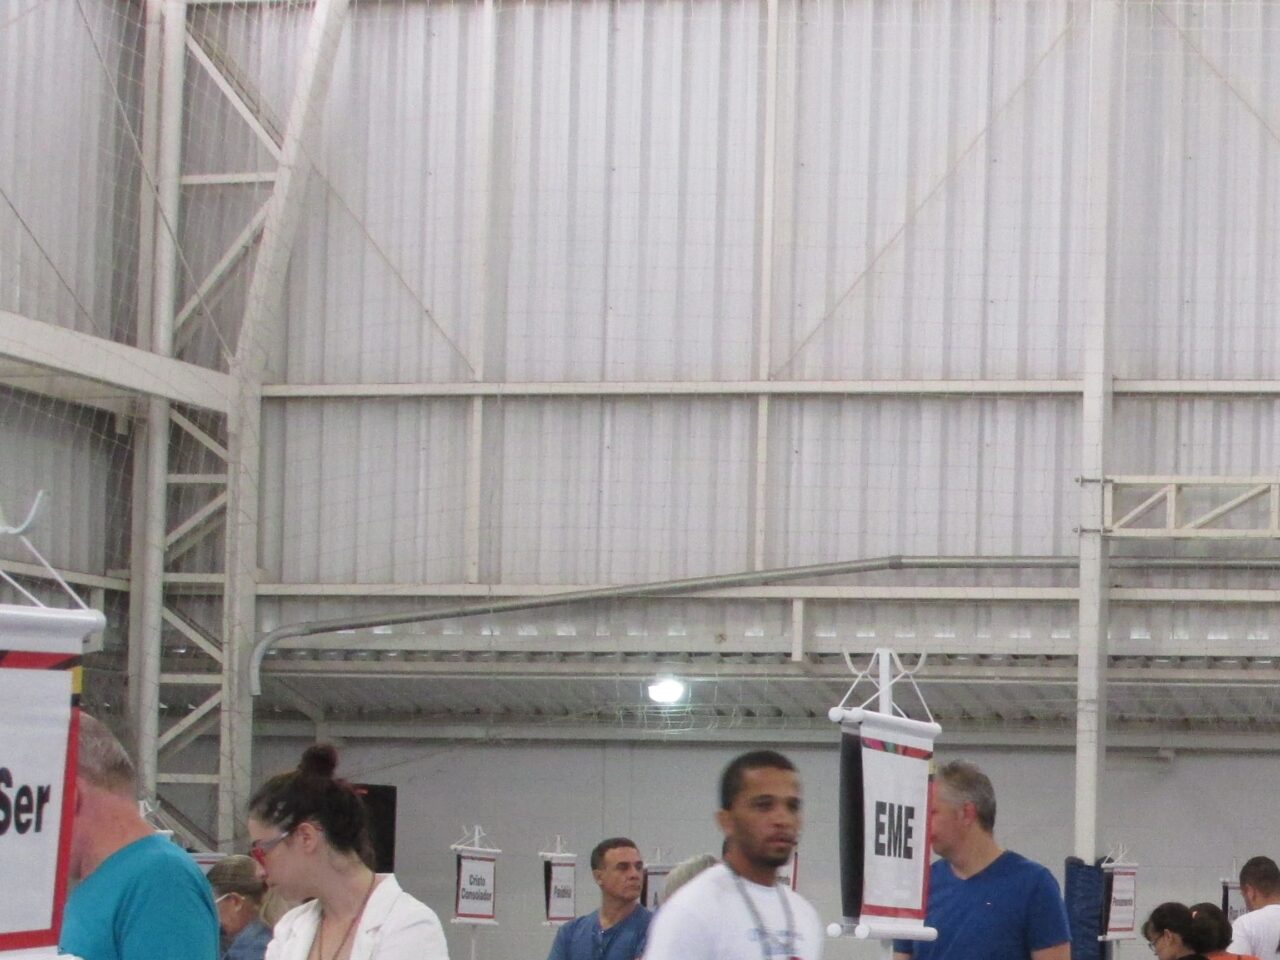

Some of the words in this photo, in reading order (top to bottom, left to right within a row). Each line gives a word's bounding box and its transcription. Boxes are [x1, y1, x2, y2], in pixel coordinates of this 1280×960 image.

[874, 800, 915, 859] EME
[469, 874, 486, 887] Cristo
[461, 888, 493, 901] Consolador
